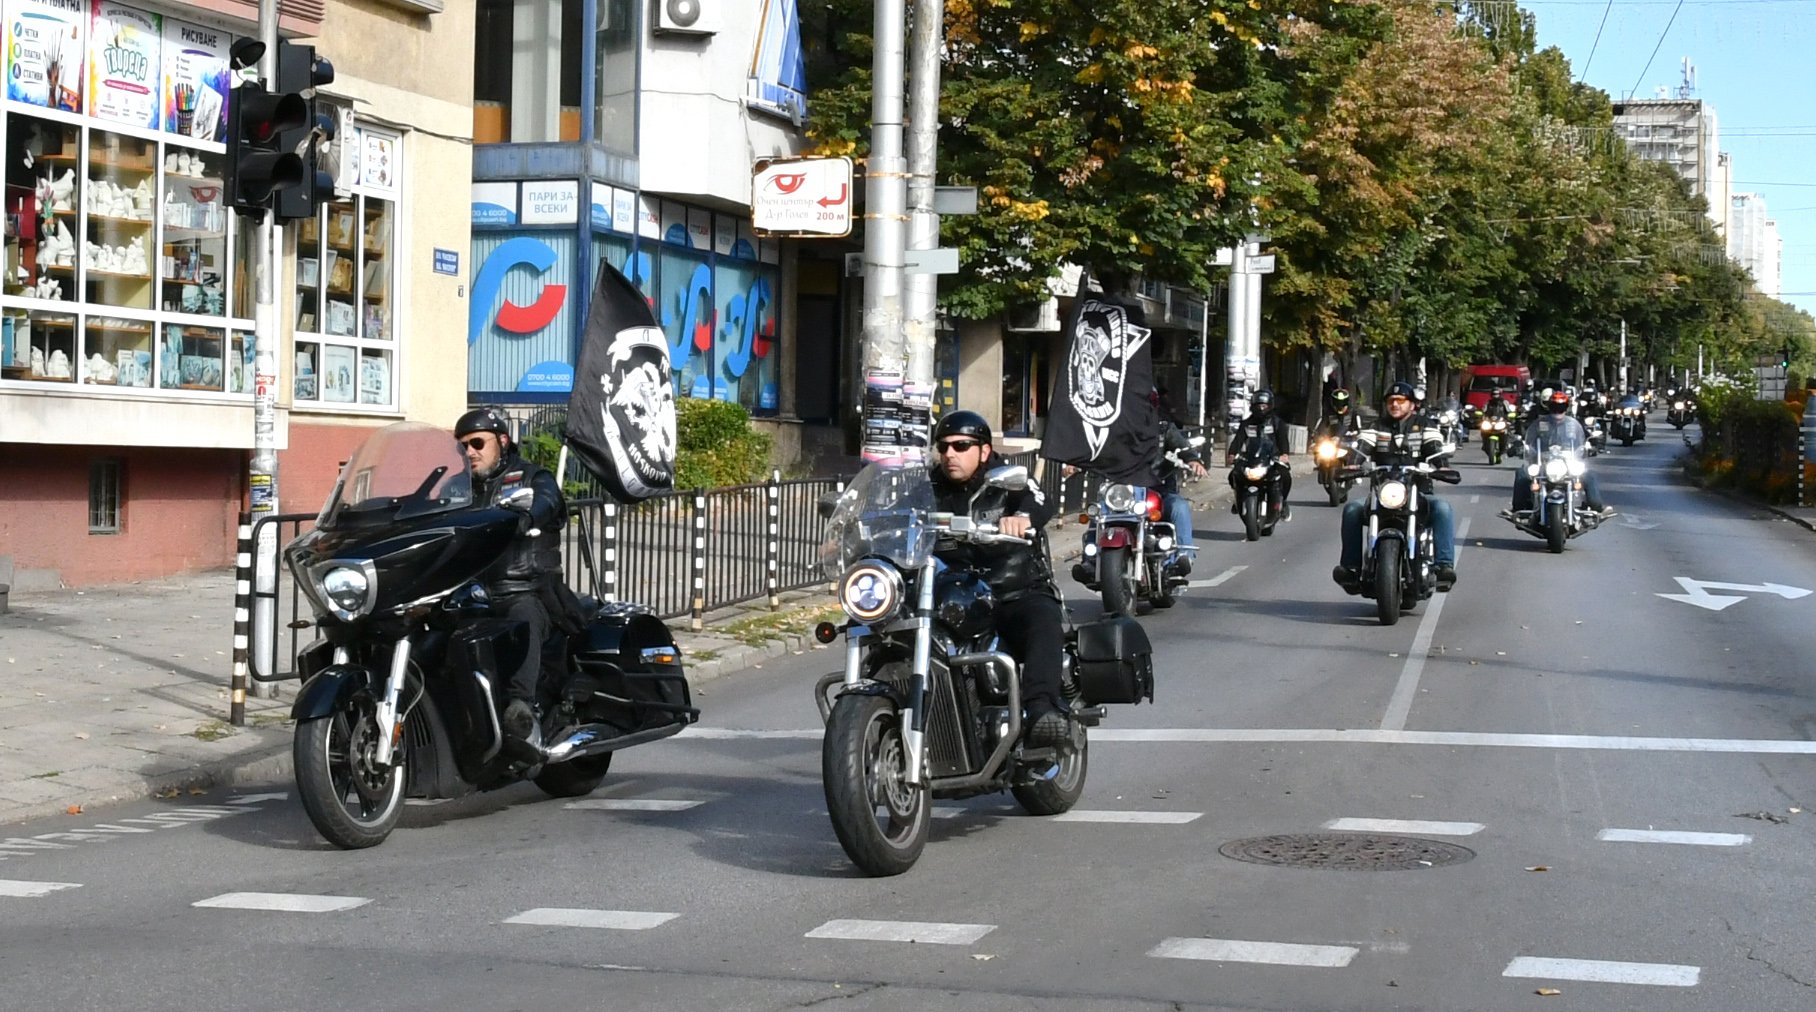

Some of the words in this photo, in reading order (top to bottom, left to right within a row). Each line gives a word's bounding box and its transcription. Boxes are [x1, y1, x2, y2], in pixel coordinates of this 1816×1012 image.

[181, 27, 217, 48] РИСУВАНЕ
[529, 192, 558, 201] ПАРИ
[534, 204, 568, 213] ВСЕКИ
[816, 212, 835, 220] 200
[527, 373, 545, 381] 0700
